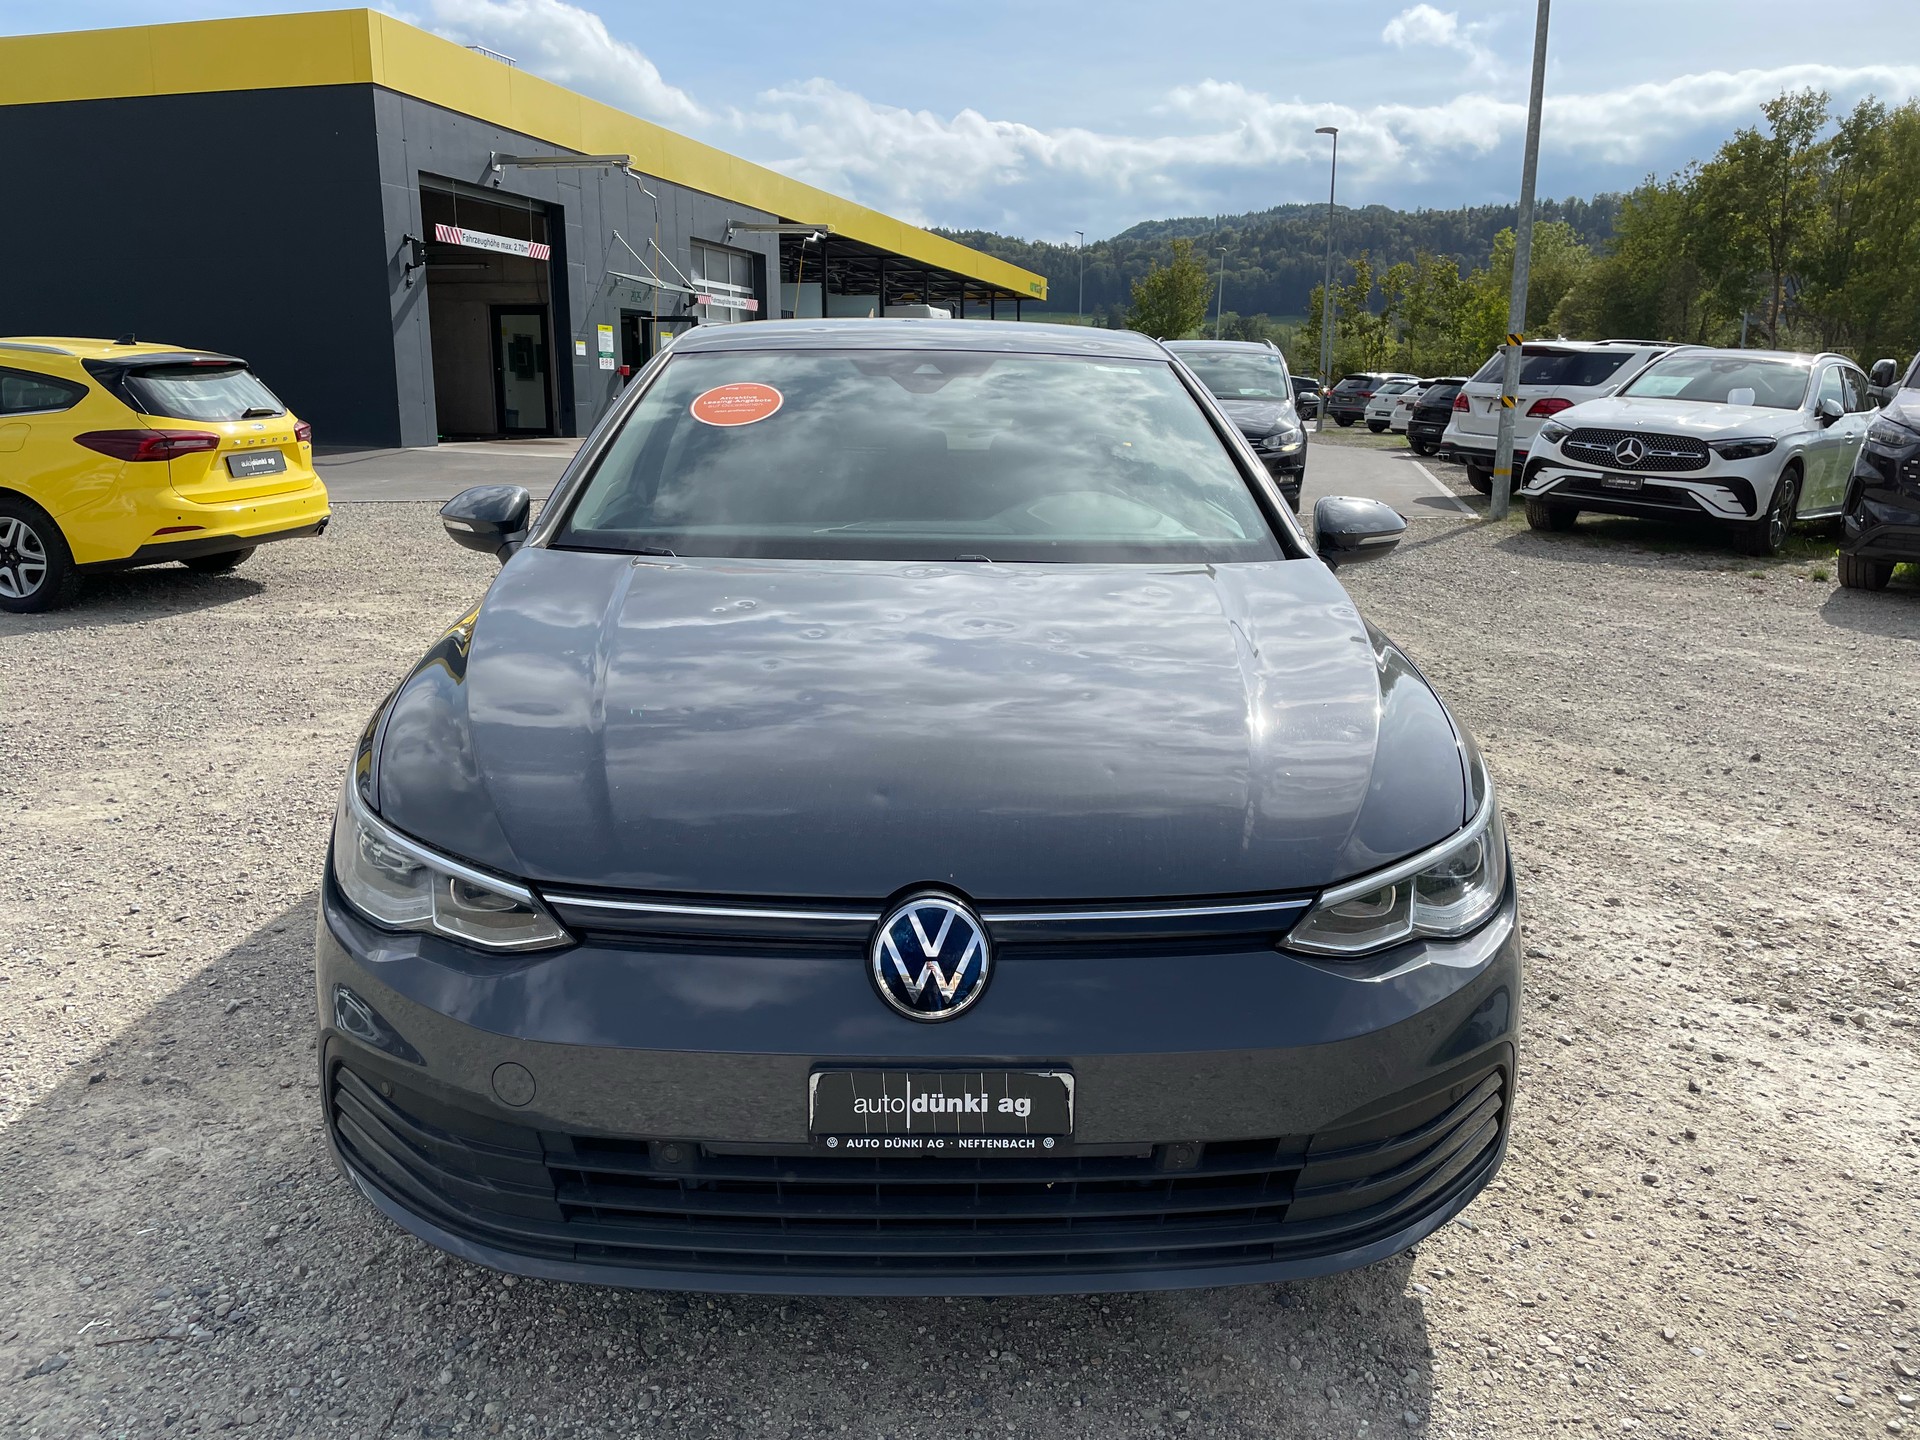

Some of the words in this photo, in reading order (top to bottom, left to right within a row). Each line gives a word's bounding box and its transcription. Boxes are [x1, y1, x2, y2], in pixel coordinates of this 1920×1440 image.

[462, 233, 500, 248] Fahrzeughöhe
[501, 242, 513, 251] max.
[514, 243, 529, 253] 2.70m
[997, 1096, 1031, 1117] ag
[846, 1138, 880, 1148] AUTO
[884, 1137, 923, 1148] DÜNKI
[926, 1138, 945, 1148] AG
[958, 1138, 1035, 1149] NEFTENBACH
